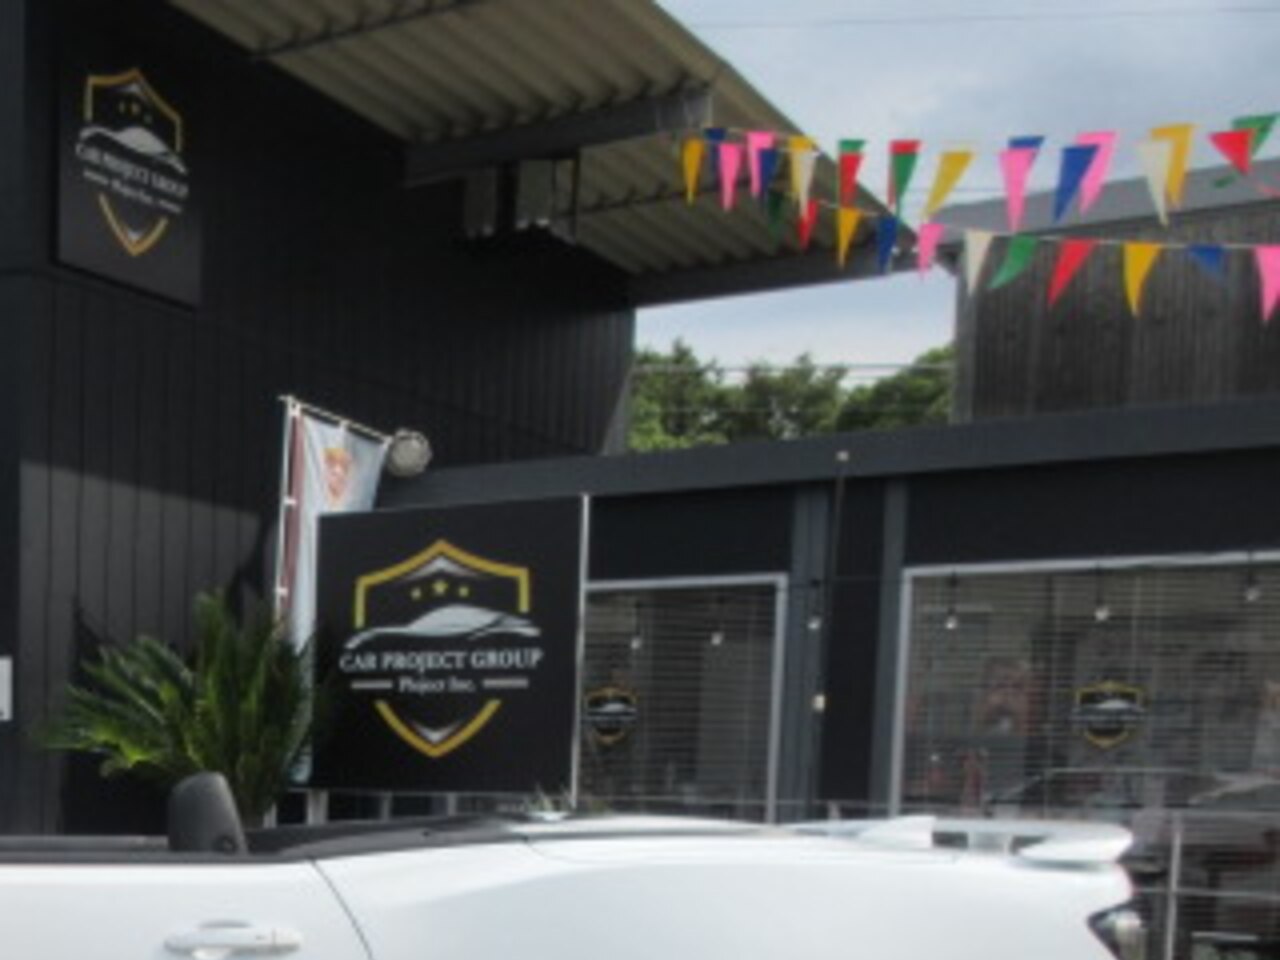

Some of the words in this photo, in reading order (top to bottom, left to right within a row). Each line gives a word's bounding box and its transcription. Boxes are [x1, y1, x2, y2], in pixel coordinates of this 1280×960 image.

[339, 652, 377, 672] CAR
[382, 651, 469, 673] PROJECT
[470, 647, 544, 669] GROUP
